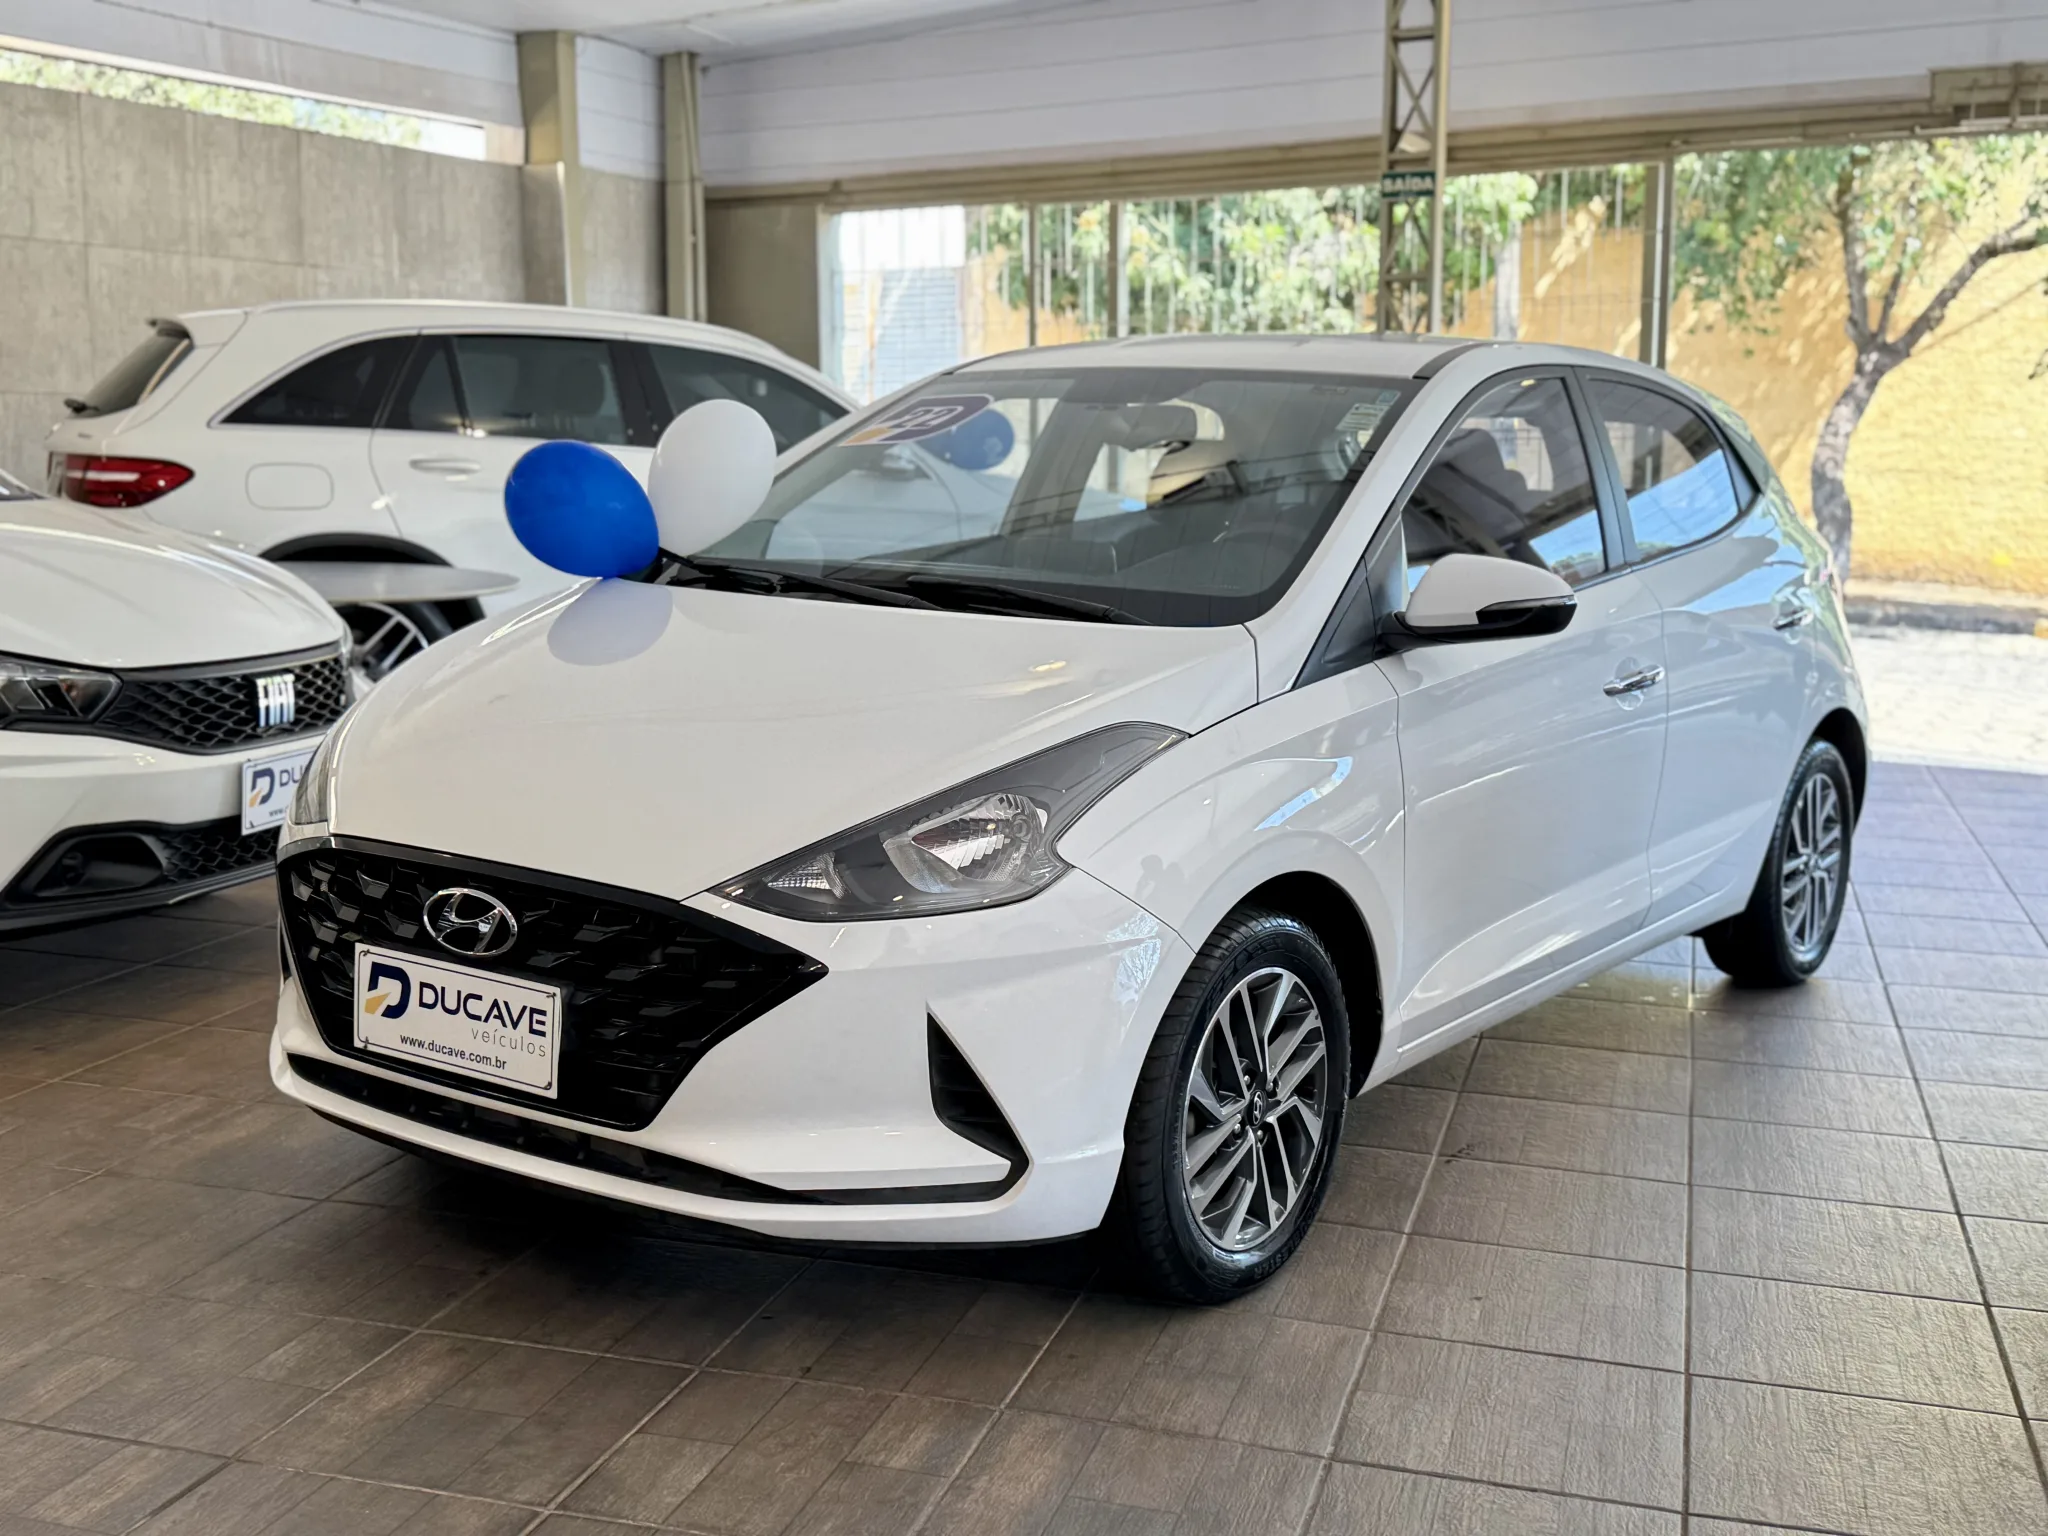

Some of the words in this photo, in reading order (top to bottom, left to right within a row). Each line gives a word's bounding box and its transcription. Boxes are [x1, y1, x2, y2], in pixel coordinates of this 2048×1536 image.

[1383, 174, 1434, 193] SAÍDA
[255, 673, 296, 728] FIAT
[418, 981, 548, 1038] DUCAVE
[399, 1034, 508, 1071] www.ducave.com.br
[471, 1027, 547, 1058] veículos
